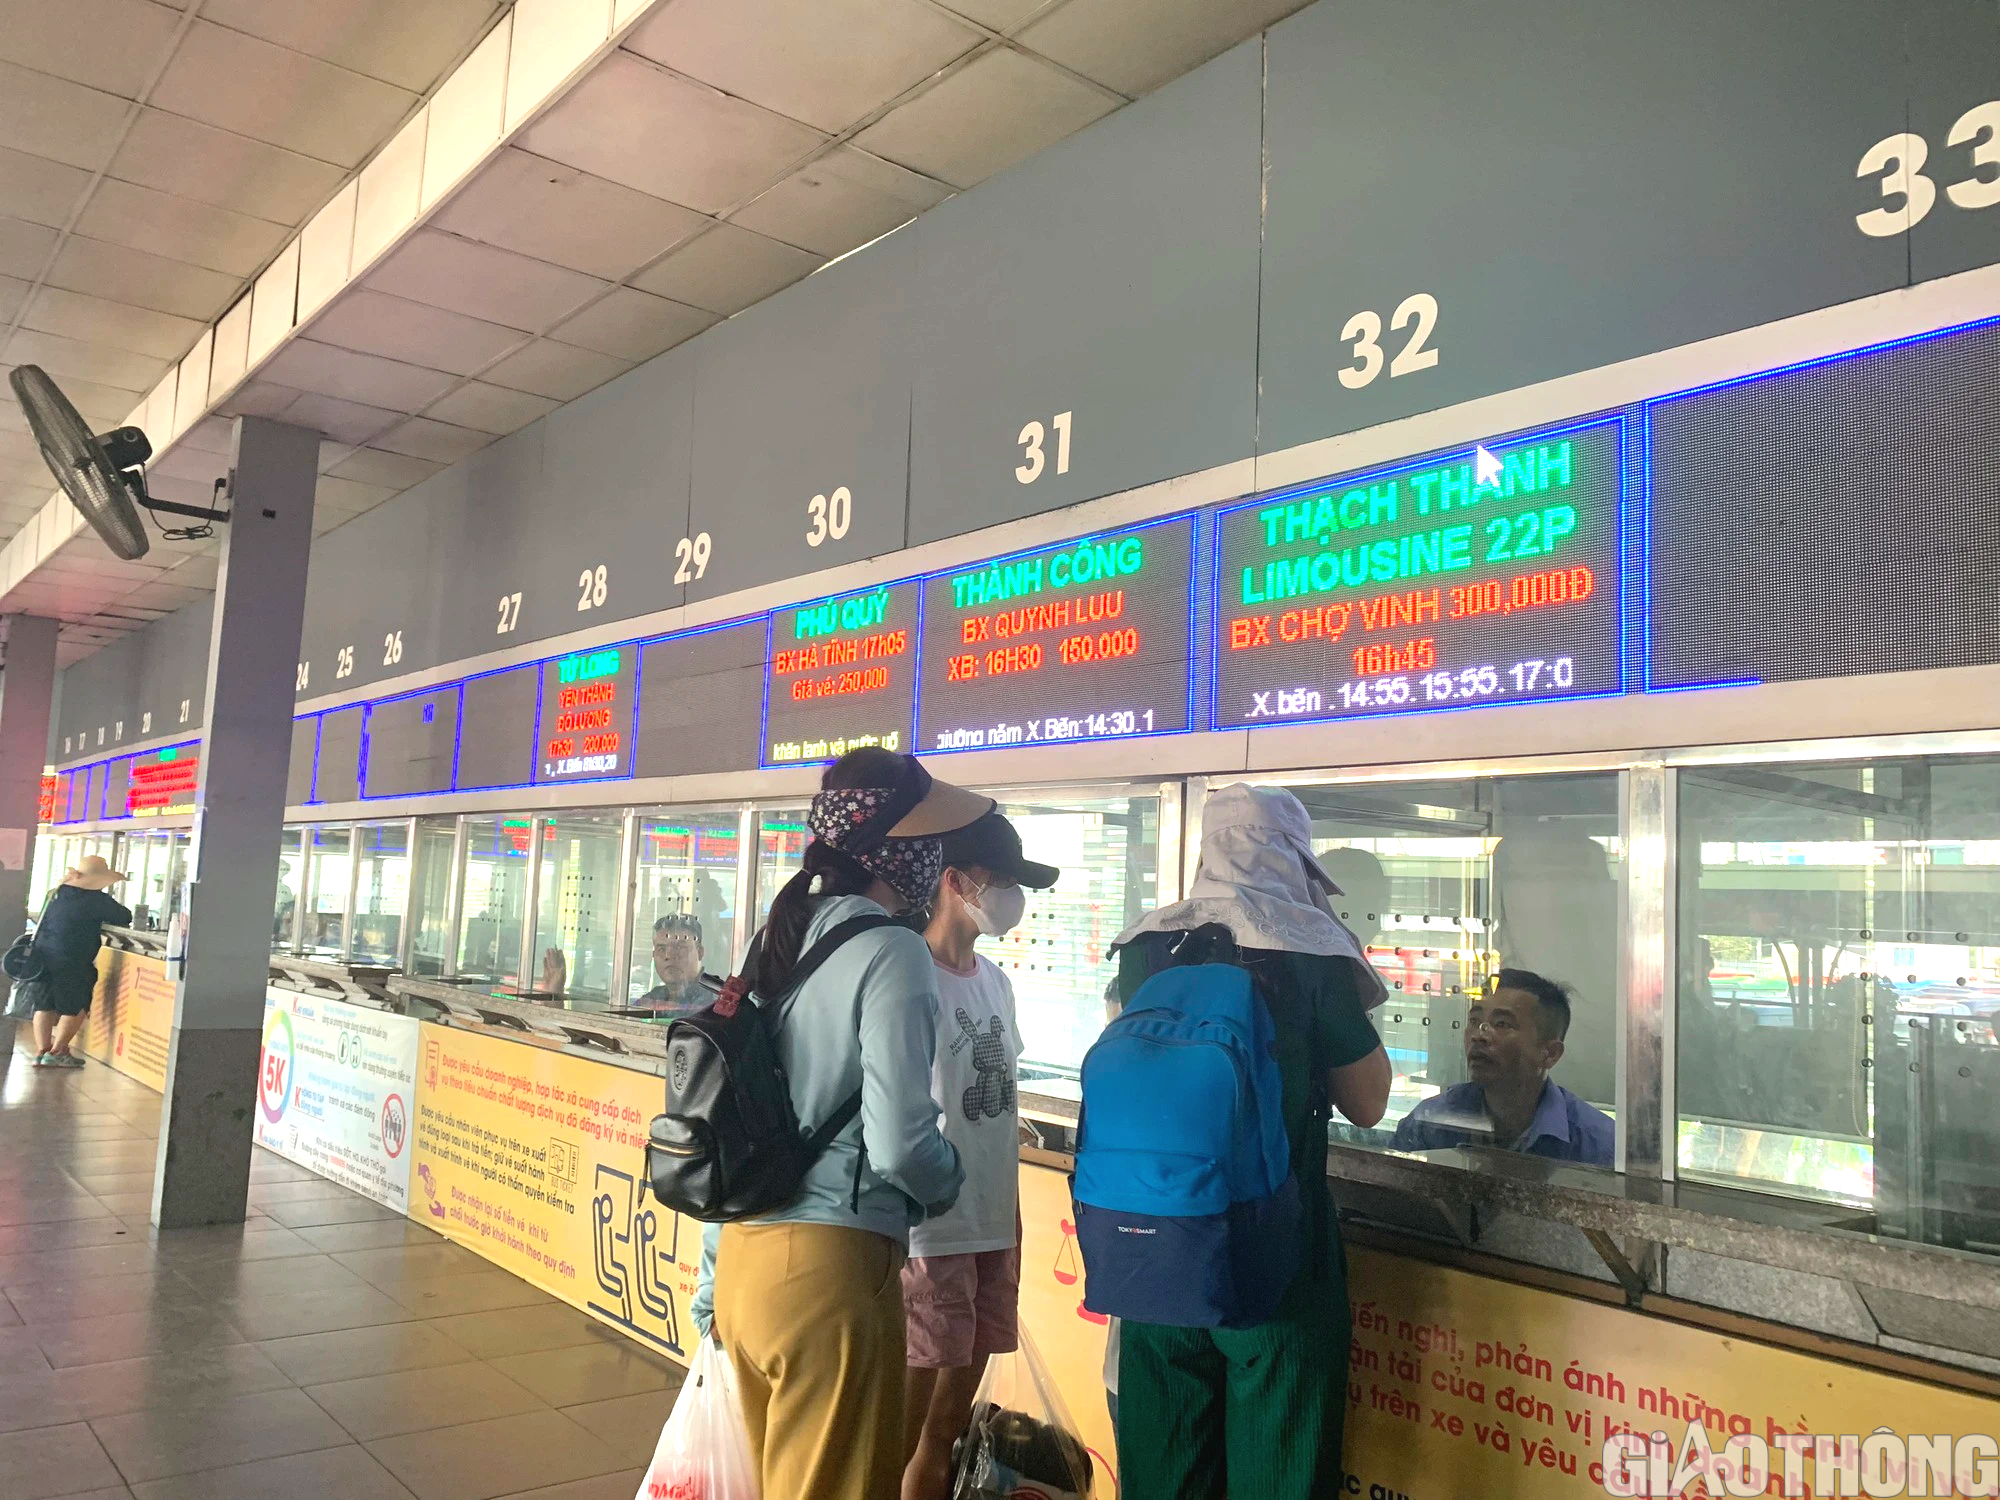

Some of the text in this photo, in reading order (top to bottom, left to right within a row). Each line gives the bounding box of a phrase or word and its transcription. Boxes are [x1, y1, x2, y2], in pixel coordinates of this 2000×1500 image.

[1855, 100, 2000, 237] 33
[1337, 293, 1439, 389] 32
[1015, 410, 1072, 484] 31
[806, 486, 851, 547] 30
[1260, 482, 1398, 546] THẠCH
[674, 532, 711, 584] 29
[952, 538, 1143, 608] THÀNH CÔNG
[1242, 504, 1577, 604] LIMOUSINE 22P
[577, 565, 608, 611] 28
[497, 592, 522, 634] 27
[795, 585, 889, 639] PHÚ QUÝ
[962, 616, 990, 643] BX
[1230, 614, 1272, 650] BX
[1278, 603, 1353, 642] CHỢ
[1359, 587, 1441, 632] VINH
[336, 646, 353, 679] 25
[383, 630, 402, 666] 26
[580, 650, 620, 680] LONG
[775, 630, 906, 674] BX HÀ TĨNH 17h05
[948, 628, 1139, 681] XB: 16H30 150.000
[1353, 637, 1436, 676] 16h45
[296, 661, 309, 691] 24
[559, 686, 579, 708] YÊN
[792, 666, 888, 700] Giá vé: 250,000
[142, 712, 151, 733] 20
[179, 699, 190, 723] 21
[266, 1055, 287, 1095] 5K
[485, 1067, 506, 1084] doanh
[552, 1086, 564, 1101] tác
[579, 1096, 600, 1116] cung
[602, 1098, 619, 1120] cấp
[622, 1106, 641, 1126] dịch
[537, 1103, 554, 1121] dịch
[555, 1111, 564, 1128] vụ
[567, 1113, 578, 1128] đã
[580, 1117, 601, 1140] đăng
[604, 1123, 614, 1143] ký
[616, 1128, 627, 1144] và
[505, 1155, 513, 1168] vé
[513, 1159, 528, 1174] suốt
[528, 1163, 545, 1181] hành
[522, 1145, 530, 1156] xe
[531, 1147, 547, 1162] xuất
[498, 1172, 506, 1184] có
[564, 1197, 575, 1214] tra
[516, 1217, 525, 1232] vé
[528, 1222, 539, 1238] khi
[526, 1243, 541, 1262] theo
[543, 1254, 557, 1273] quy
[558, 1260, 575, 1279] định
[679, 1262, 691, 1276] quy
[1352, 1301, 1388, 1335] iến
[1398, 1320, 1464, 1361] nghị,
[1475, 1341, 1552, 1382] phản
[1563, 1359, 1625, 1404] ánh
[1638, 1386, 1751, 1448] những
[1370, 1383, 1421, 1423] trên
[1431, 1408, 1464, 1436] xe
[1474, 1422, 1510, 1453] và
[1521, 1438, 1576, 1477] yêu
[1388, 1348, 1421, 1385] tải
[1431, 1366, 1485, 1404] của
[1495, 1386, 1553, 1426] đơn
[1565, 1409, 1591, 1446] vị
[1604, 1416, 1674, 1464] kinh
[1688, 1446, 1811, 1500] doanh
